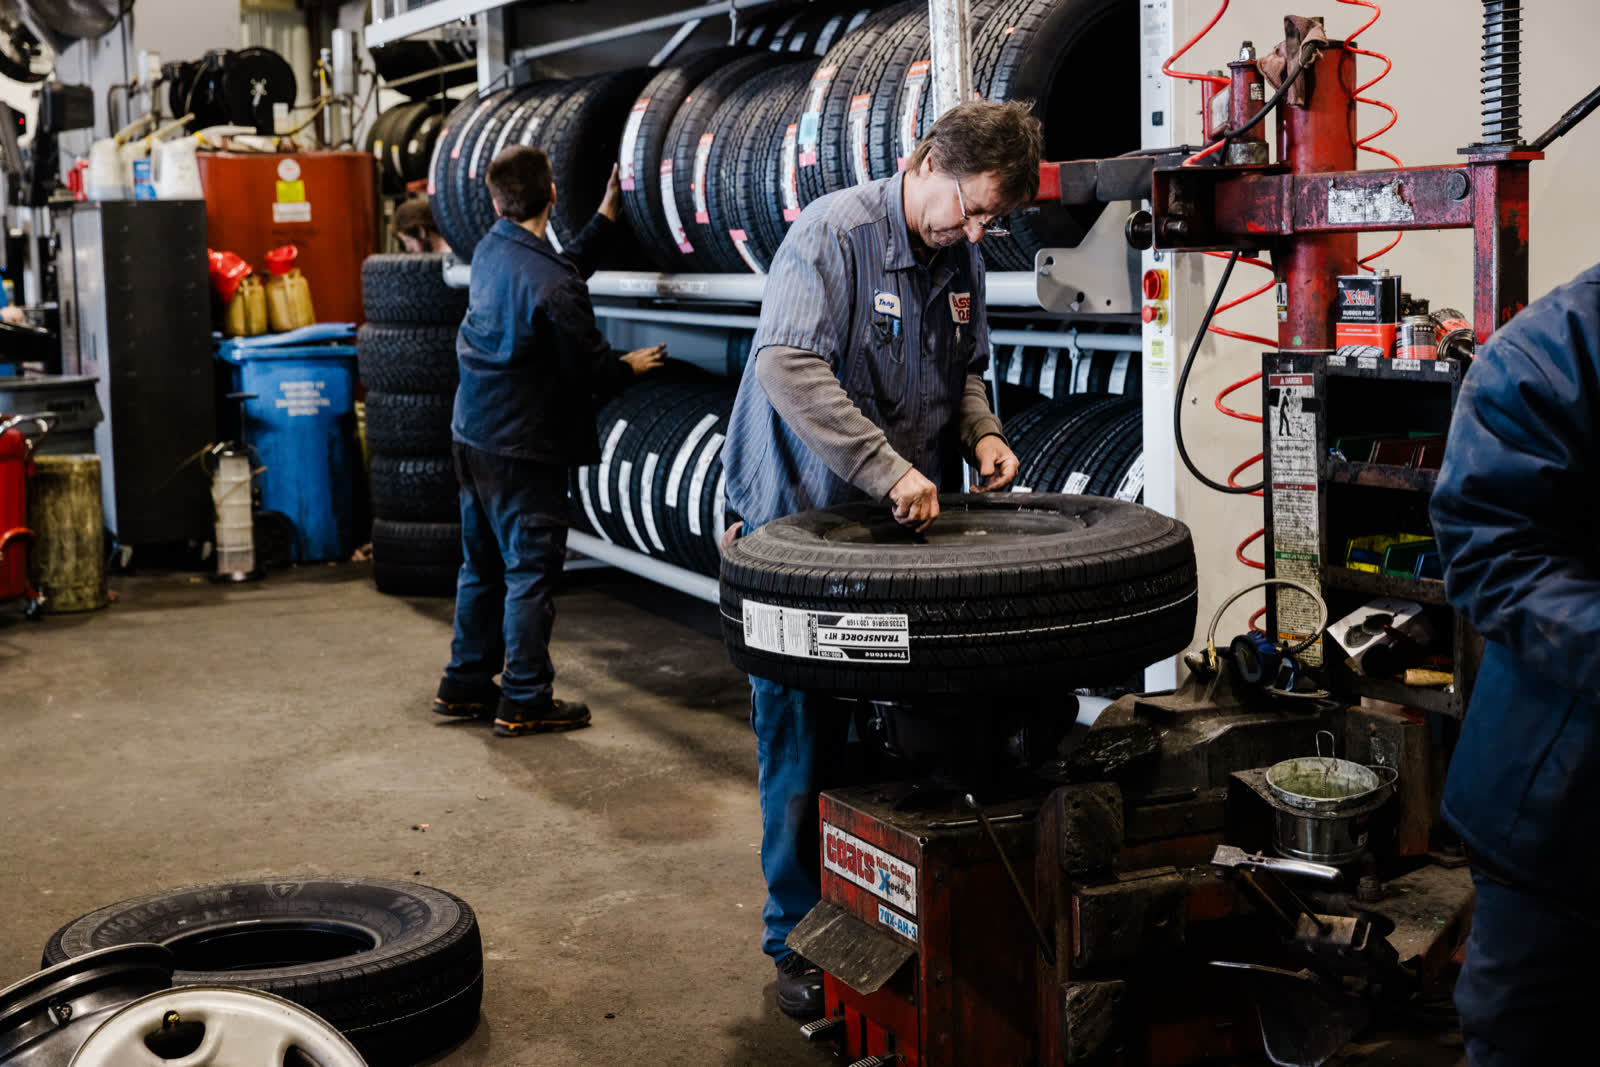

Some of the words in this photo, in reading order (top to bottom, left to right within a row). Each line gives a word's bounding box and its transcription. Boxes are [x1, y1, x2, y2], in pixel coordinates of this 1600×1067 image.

[840, 632, 900, 643] TRANSFORCE
[864, 651, 907, 659] Firestone
[876, 856, 889, 872] Rim
[890, 863, 911, 884] Clamp
[878, 868, 891, 895] X
